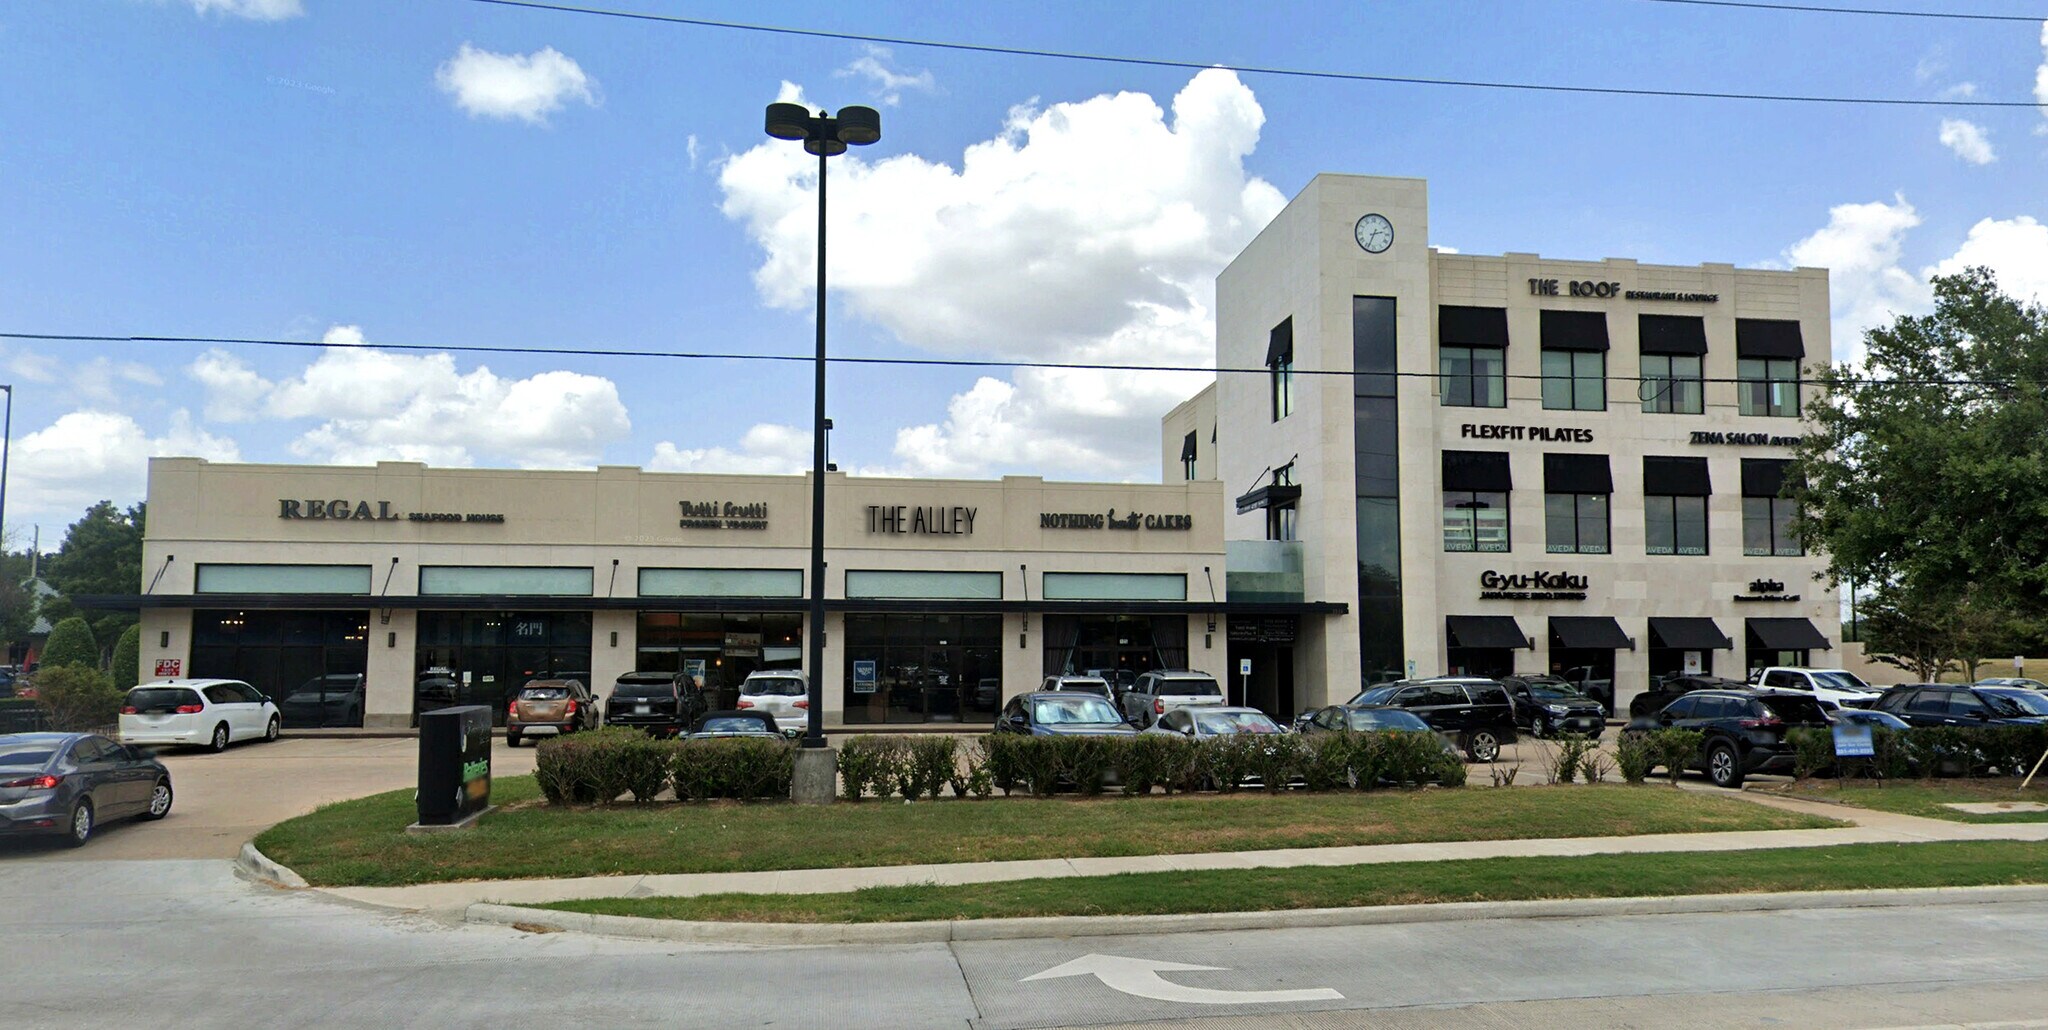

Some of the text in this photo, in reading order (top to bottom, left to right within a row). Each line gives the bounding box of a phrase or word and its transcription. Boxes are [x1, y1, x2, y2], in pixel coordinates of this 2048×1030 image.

[1528, 278, 1558, 296] THE
[1570, 280, 1620, 298] ROOF
[1461, 423, 1593, 442] FLEXFIT PILATES
[1689, 431, 1724, 444] ZENA
[1725, 432, 1768, 445] SALON
[278, 499, 504, 523] REGAL SEAFOOD HOUSE
[680, 519, 768, 530] FROZEN YOGURT
[868, 506, 978, 534] THE ALLEY
[1040, 513, 1104, 529] NOTHING
[1145, 514, 1192, 530] CAKES
[1580, 545, 1607, 553] AVEDA
[1481, 570, 1588, 590] Gyu-Kaku
[1480, 591, 1530, 600] JAPANESE
[515, 622, 543, 636] 名門
[156, 660, 180, 668] FDC
